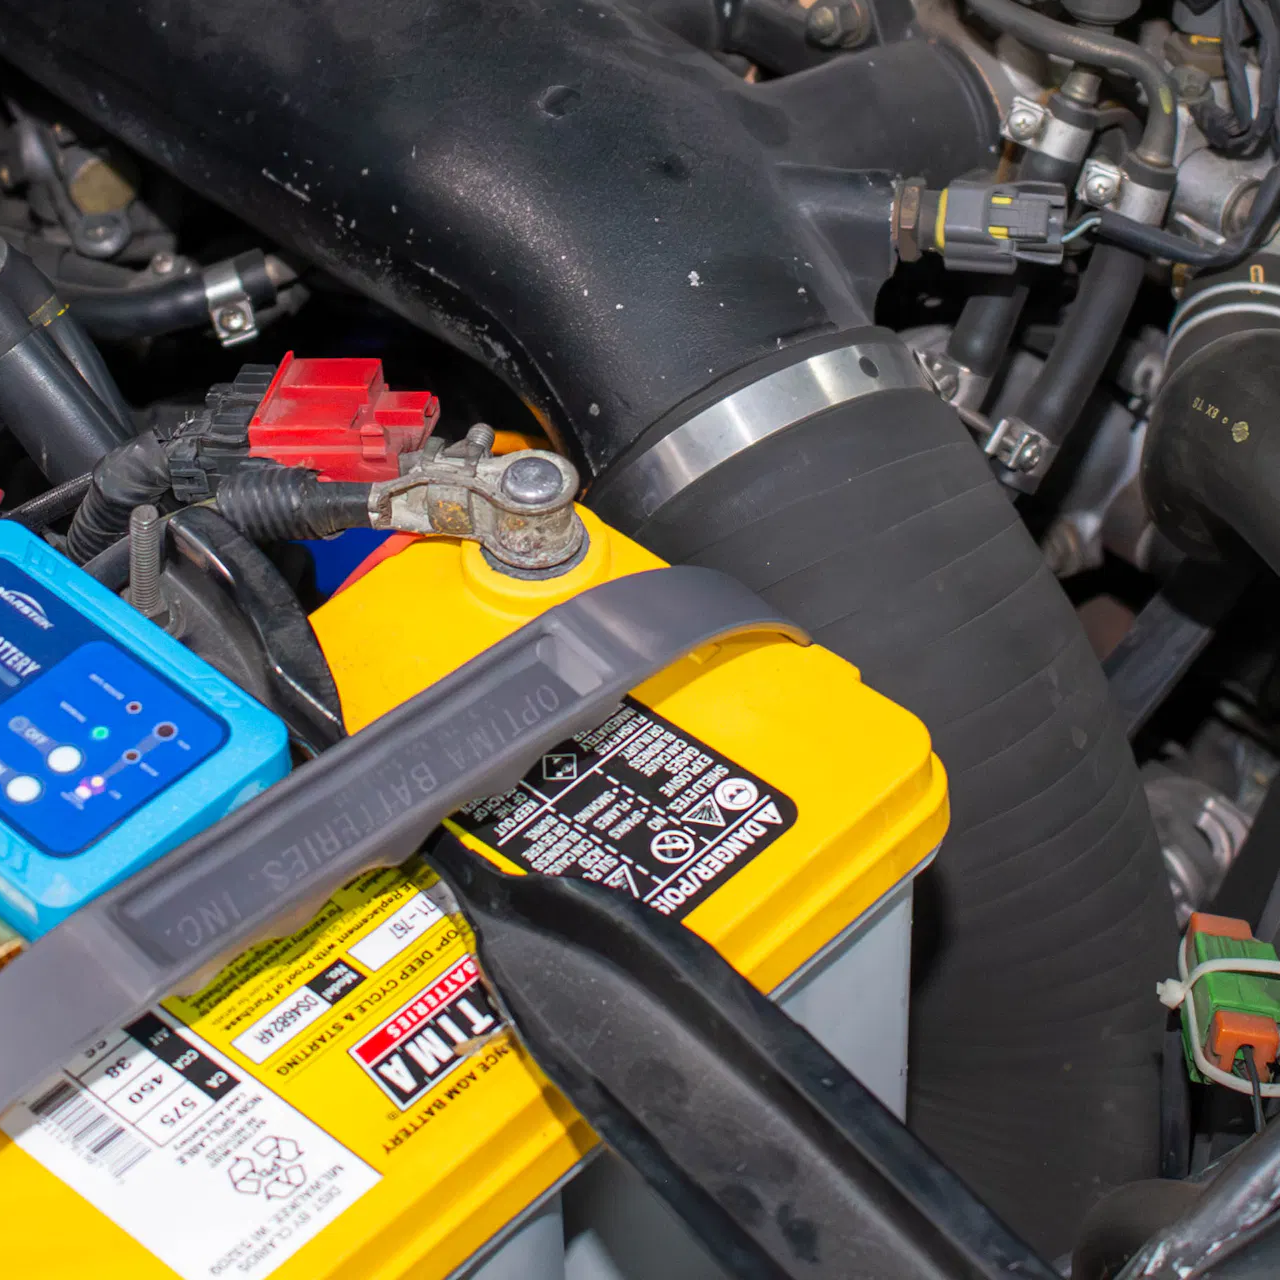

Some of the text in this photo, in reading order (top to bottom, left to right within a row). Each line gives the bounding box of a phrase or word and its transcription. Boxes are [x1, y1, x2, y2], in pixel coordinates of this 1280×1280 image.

[22, 726, 48, 746] OFF
[442, 680, 562, 775] OPTIMA
[577, 707, 636, 750] IMMEDIATELY
[614, 714, 647, 738] FLUSH
[592, 733, 622, 754] EYES
[616, 732, 655, 760] INJURY.
[626, 731, 677, 769] BLINDNESS
[639, 738, 687, 775] CAN CAUSE
[663, 746, 700, 774] GASES
[657, 753, 714, 797] EXPLOSIVE
[664, 764, 730, 815] SHIELD EYES.
[511, 798, 539, 820] KEEP
[572, 790, 615, 824] SMOKING
[591, 799, 631, 830] FLAMES
[645, 814, 668, 832] NO
[490, 814, 518, 836] OUT
[521, 814, 557, 841] BURNS.
[606, 809, 646, 840] SPARKS
[520, 831, 558, 861] SEVERE
[529, 830, 581, 871] BLINDNESS
[577, 846, 605, 868] ACID
[163, 888, 241, 957] INC.
[333, 888, 403, 945] Replacement
[311, 941, 338, 964] with
[394, 948, 435, 983] DEEP
[282, 957, 316, 985] Proof
[321, 969, 359, 1001] Model
[323, 962, 347, 982] No.
[351, 977, 399, 1016] CYCLE
[384, 960, 478, 1039] BATTERIES
[253, 993, 319, 1046] DS46B24R
[275, 1020, 345, 1078] STARTING
[376, 994, 494, 1095] TIMA
[103, 1055, 132, 1079] 38
[127, 1048, 199, 1105] CCA 450
[158, 1070, 228, 1128] CA 575
[381, 1070, 477, 1154] AGM BATTERY
[175, 1094, 263, 1166] NON-SPILLABLE
